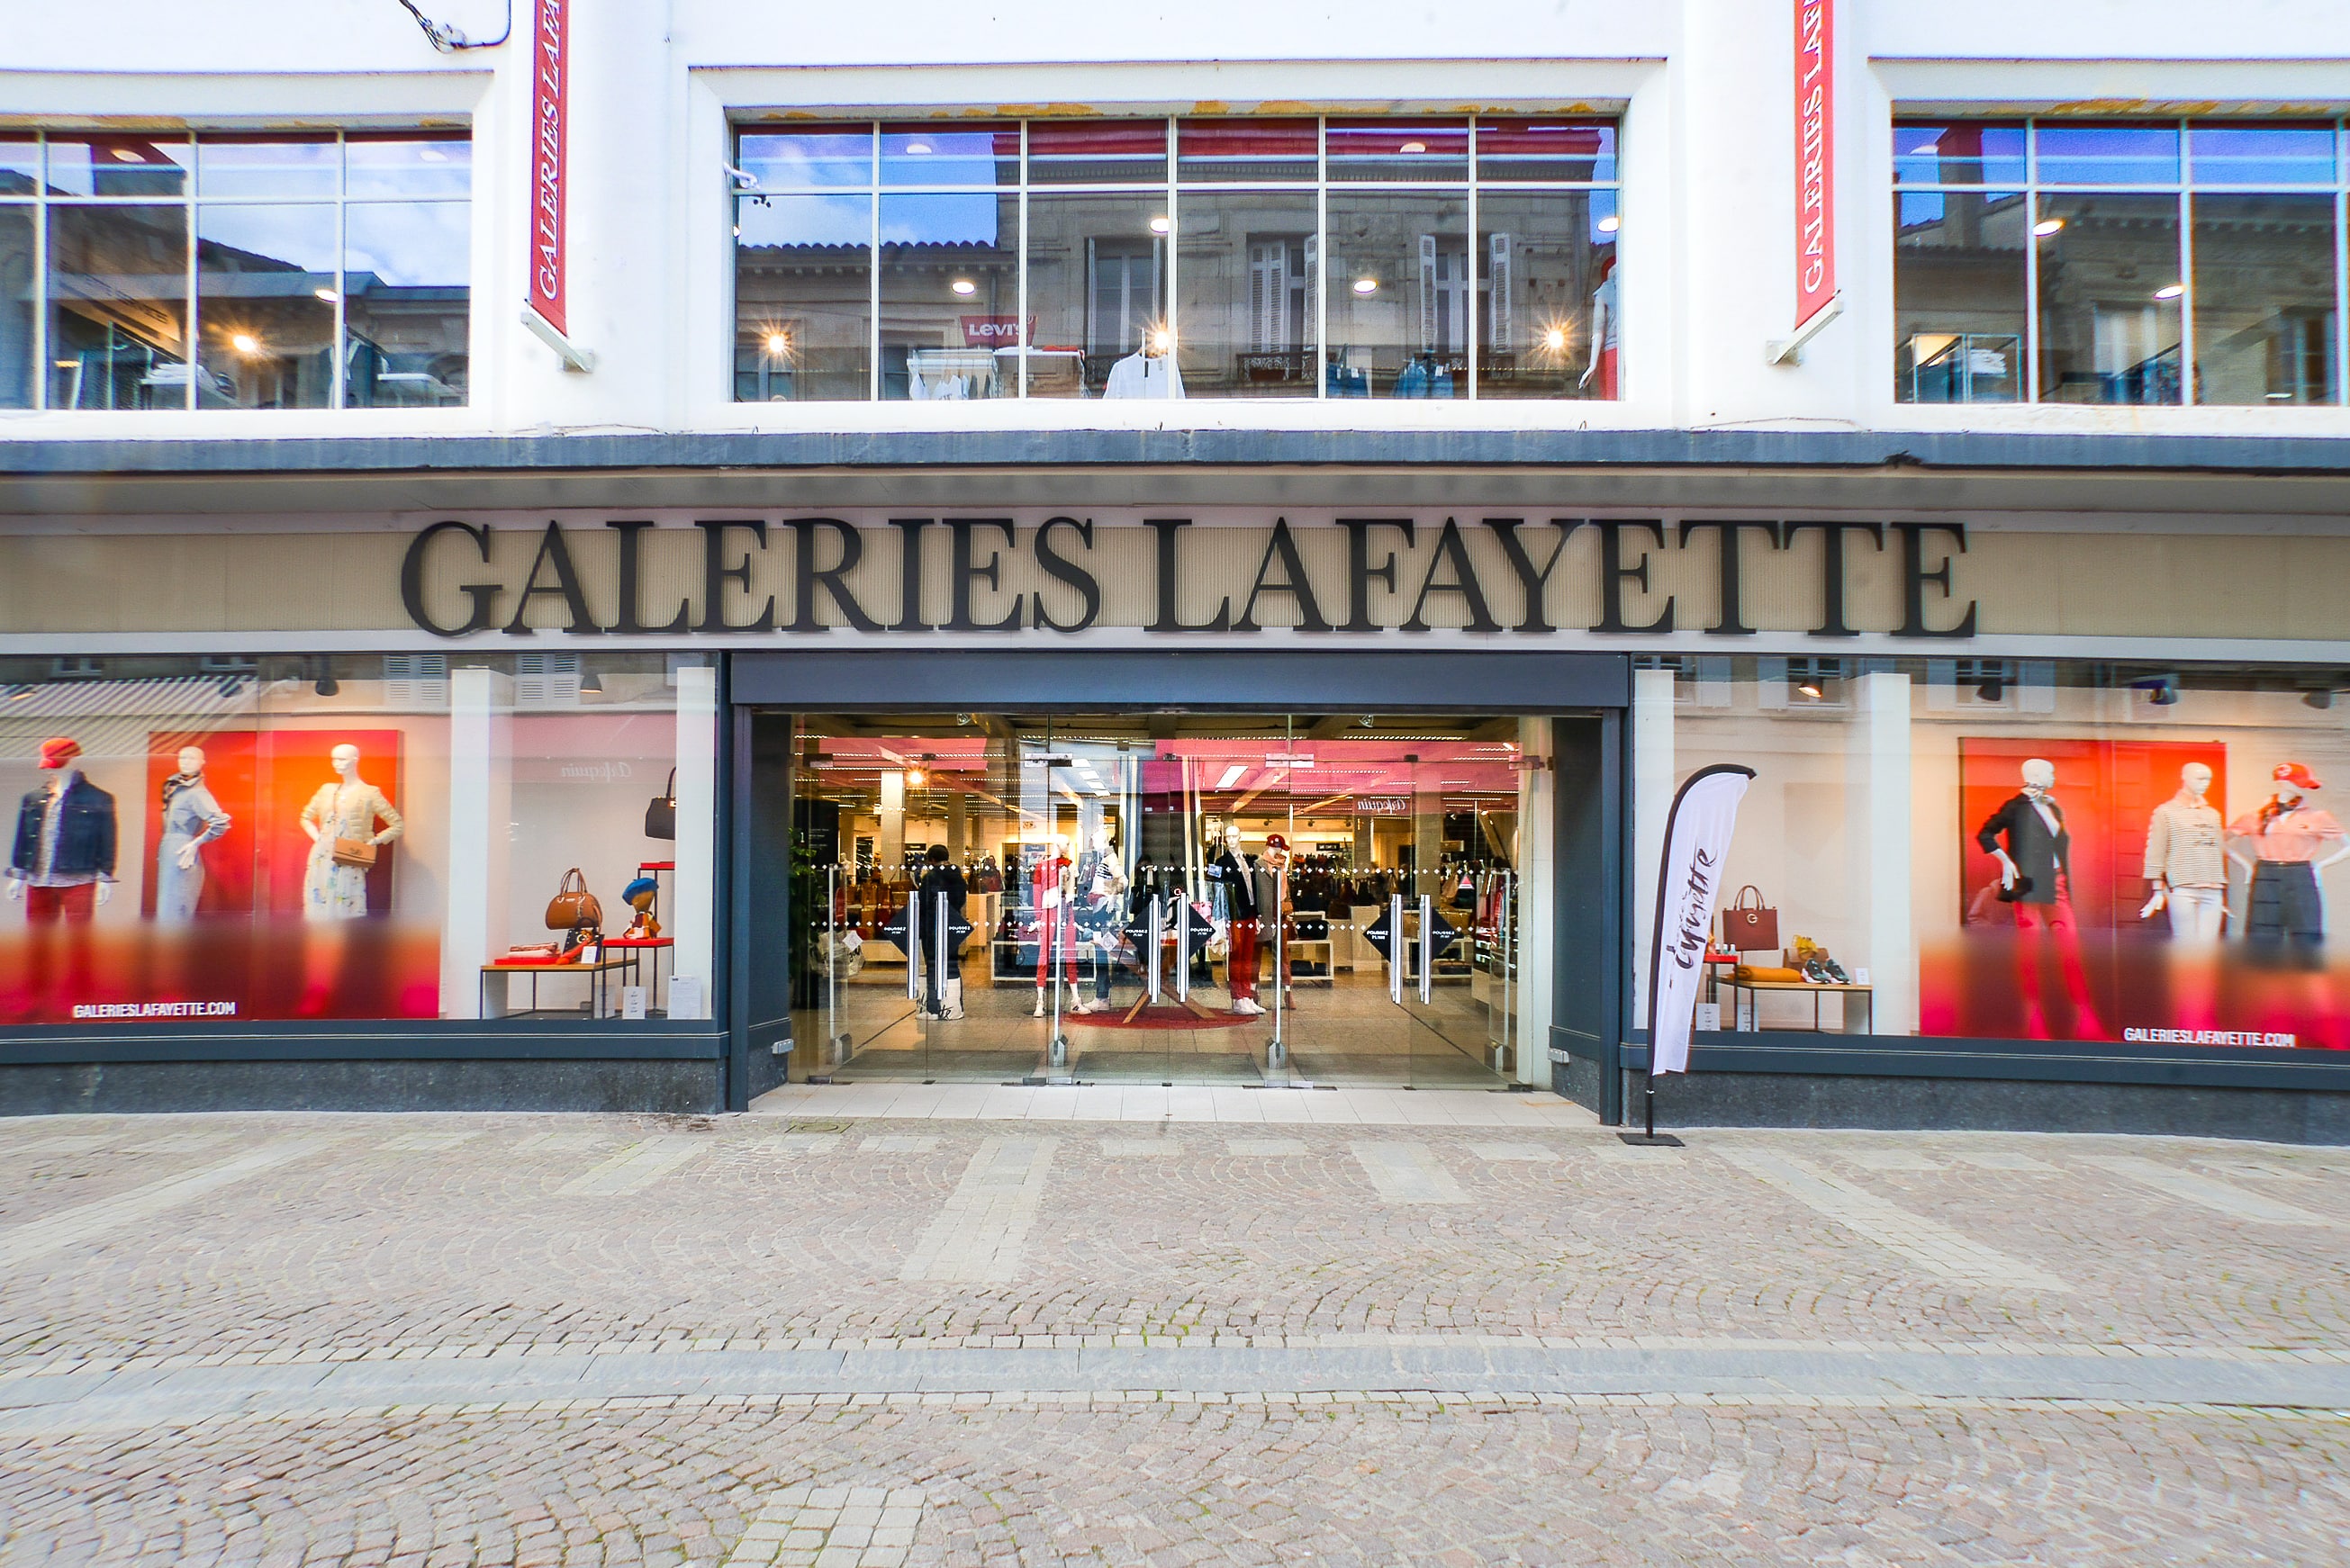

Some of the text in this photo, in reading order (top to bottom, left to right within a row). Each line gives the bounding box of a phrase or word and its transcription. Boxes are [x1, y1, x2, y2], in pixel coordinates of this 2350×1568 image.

[539, 95, 559, 301] GALERIES
[1803, 84, 1823, 293] GALERIES
[401, 517, 1976, 637] GALERIES LAFAYETTE
[72, 1001, 237, 1019] GALERIESLAFAYETTE.COM
[2123, 1027, 2296, 1048] GALERIESLAFAYETTE.COM
